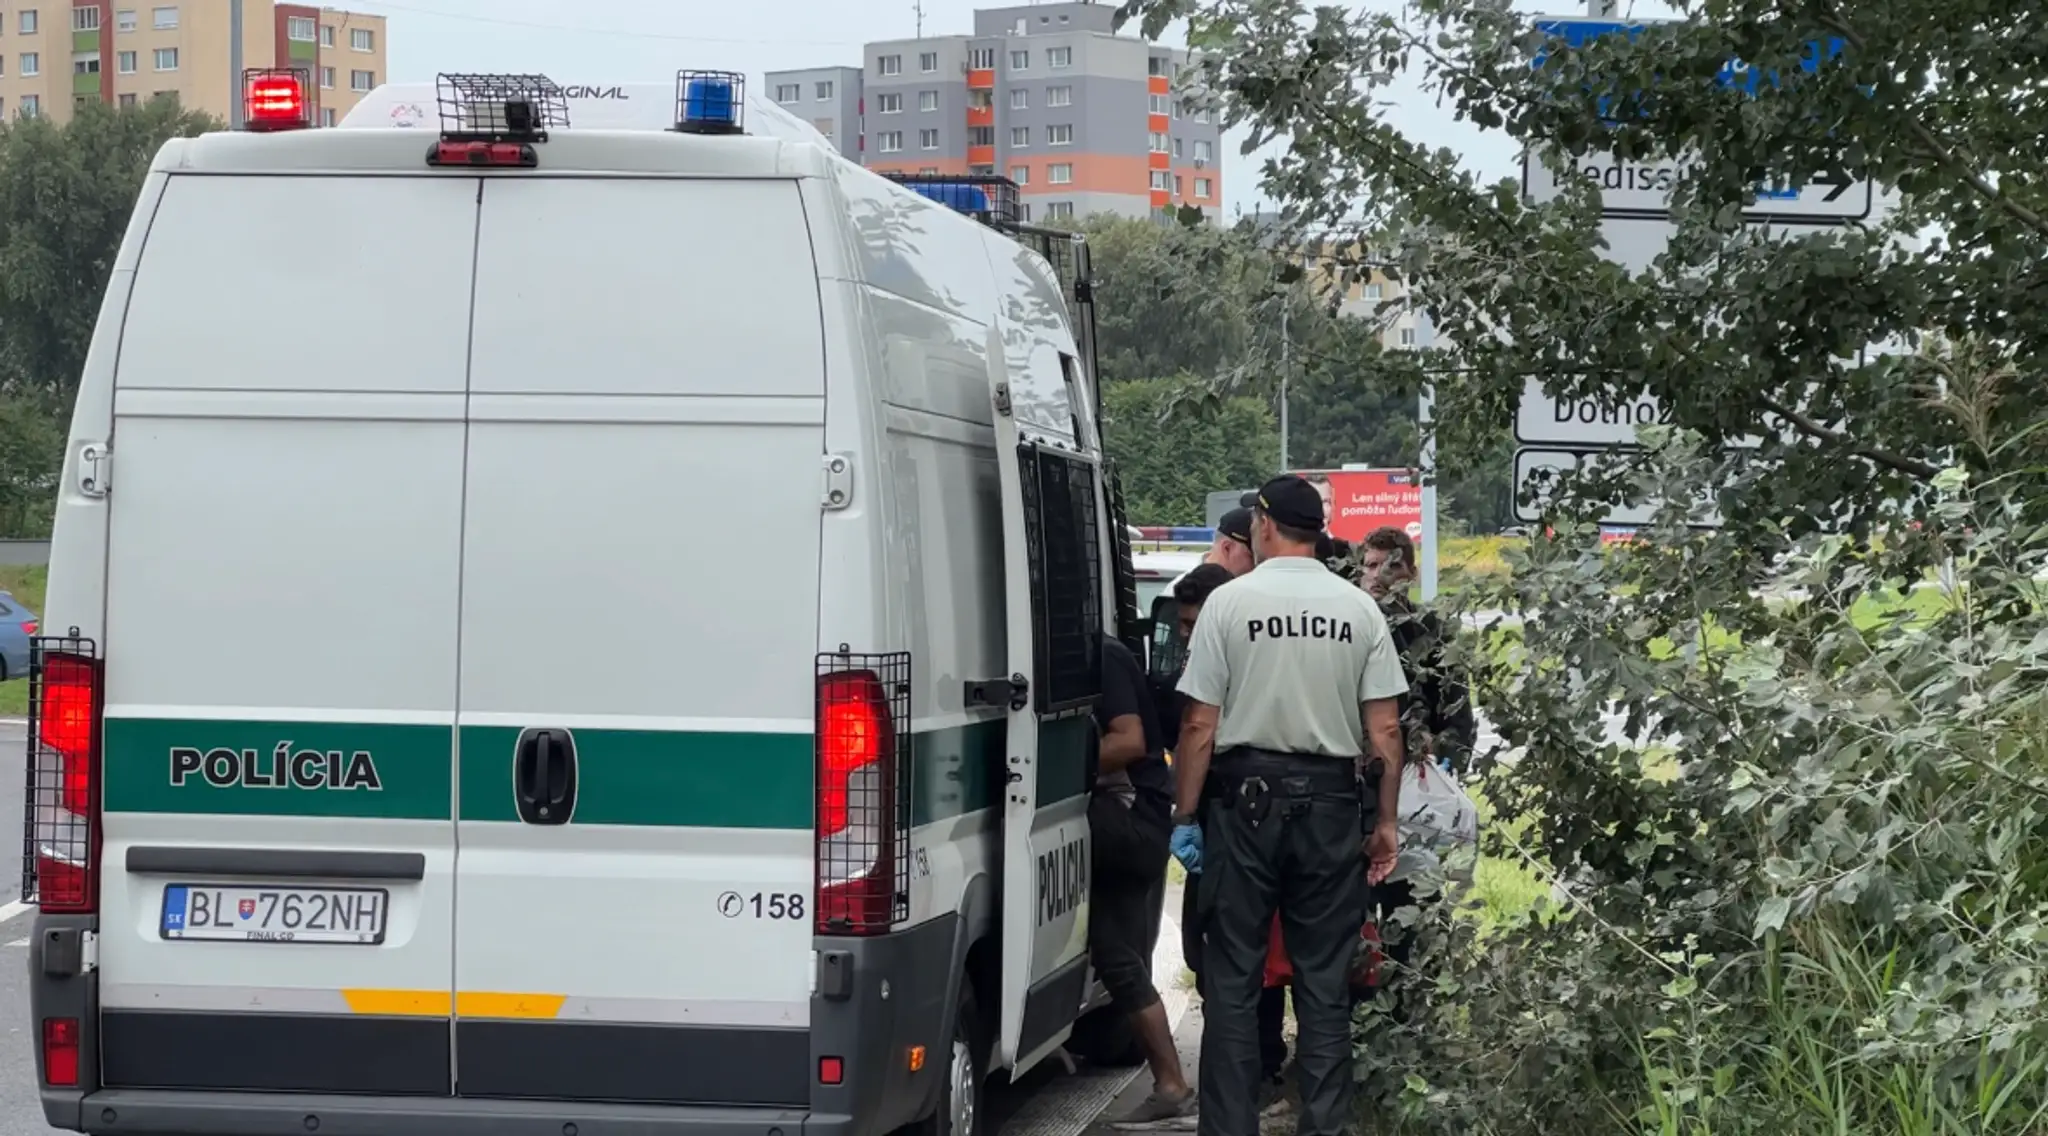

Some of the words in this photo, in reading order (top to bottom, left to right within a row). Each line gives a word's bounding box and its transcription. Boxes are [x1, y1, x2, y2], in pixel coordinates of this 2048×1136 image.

[1248, 609, 1352, 644] POLÍCIA
[170, 740, 383, 790] POLÍCIA
[1038, 828, 1086, 928] POLÍCIA
[167, 913, 182, 924] SK
[189, 891, 234, 928] BL
[258, 892, 379, 932] 762NH
[750, 892, 804, 920] 158
